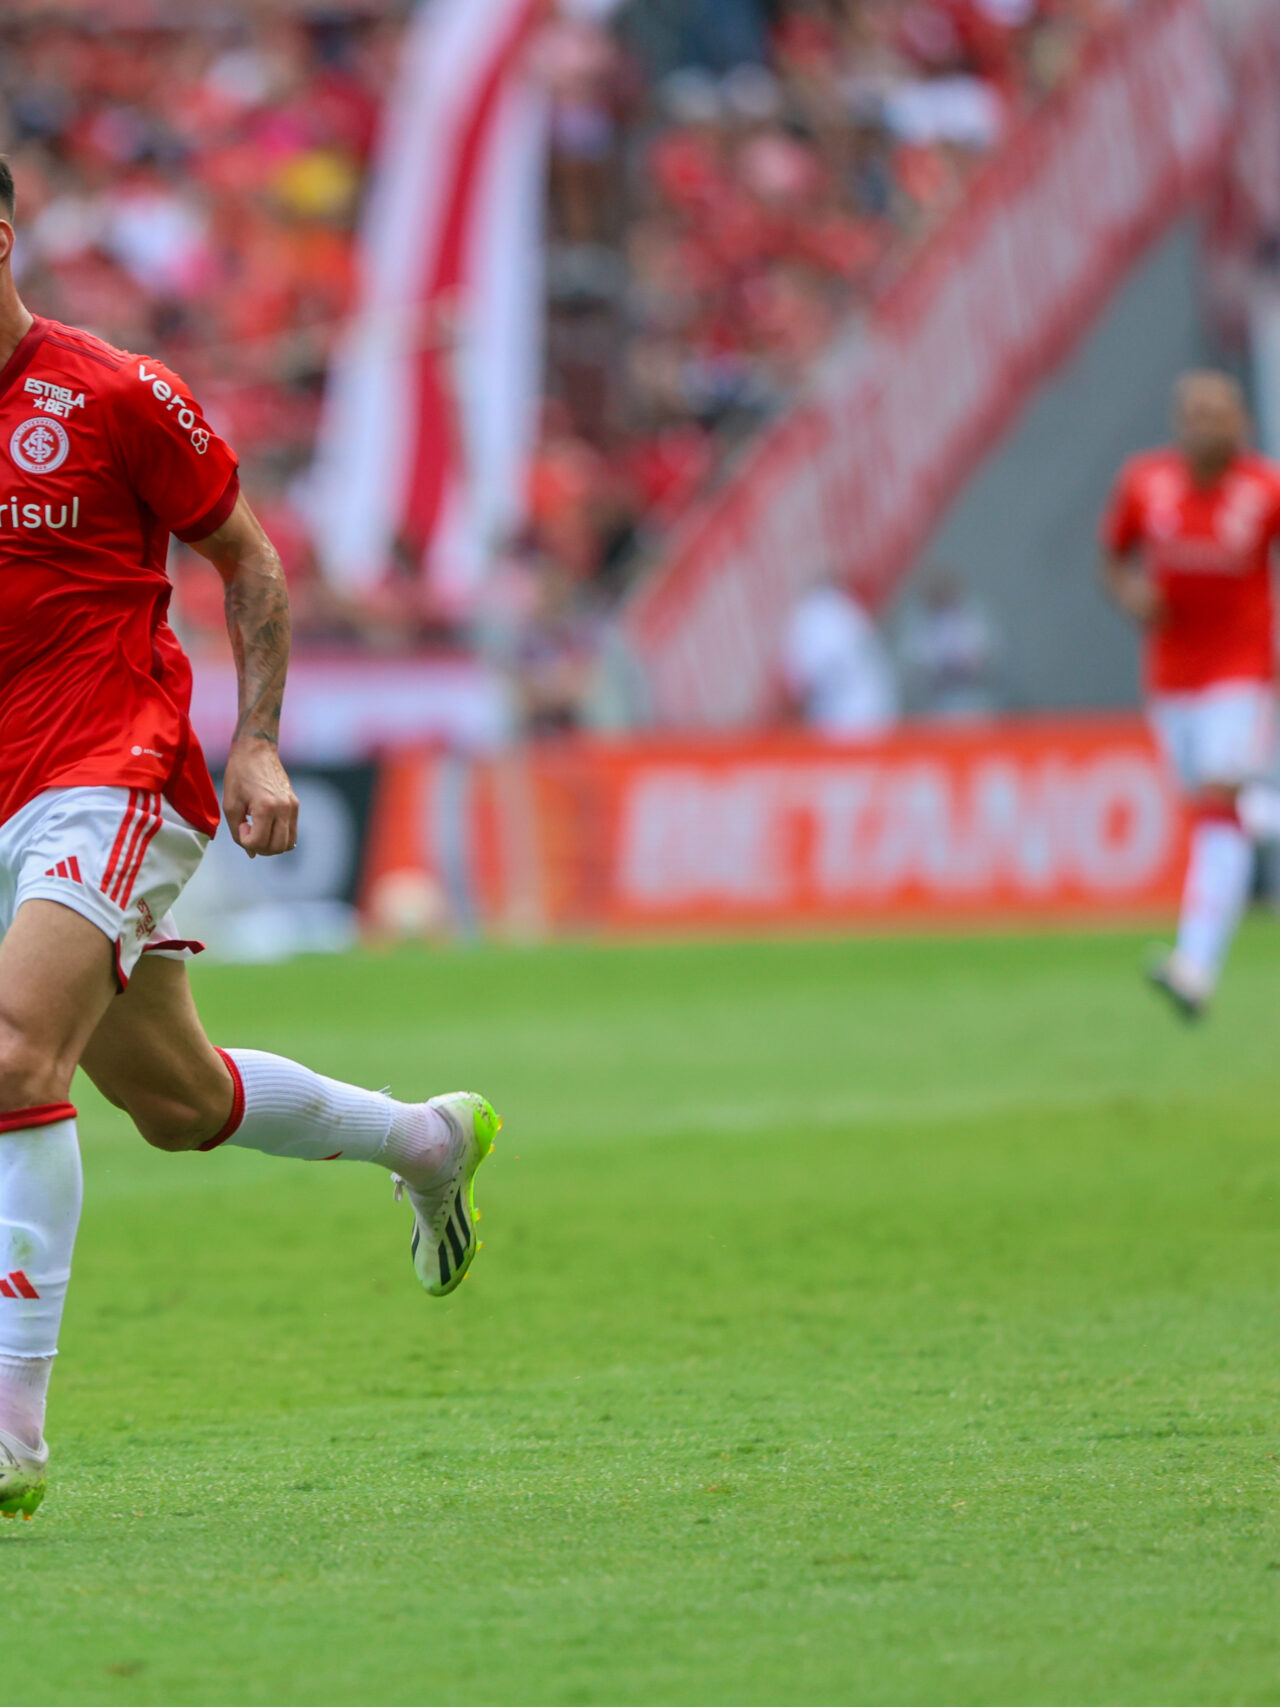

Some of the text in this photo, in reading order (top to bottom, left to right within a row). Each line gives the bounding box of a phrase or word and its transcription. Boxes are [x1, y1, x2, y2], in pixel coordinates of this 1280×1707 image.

[24, 377, 85, 409] ESTRELA
[43, 398, 73, 418] BET
[139, 364, 194, 429] vero
[621, 755, 1170, 903] BETANO
